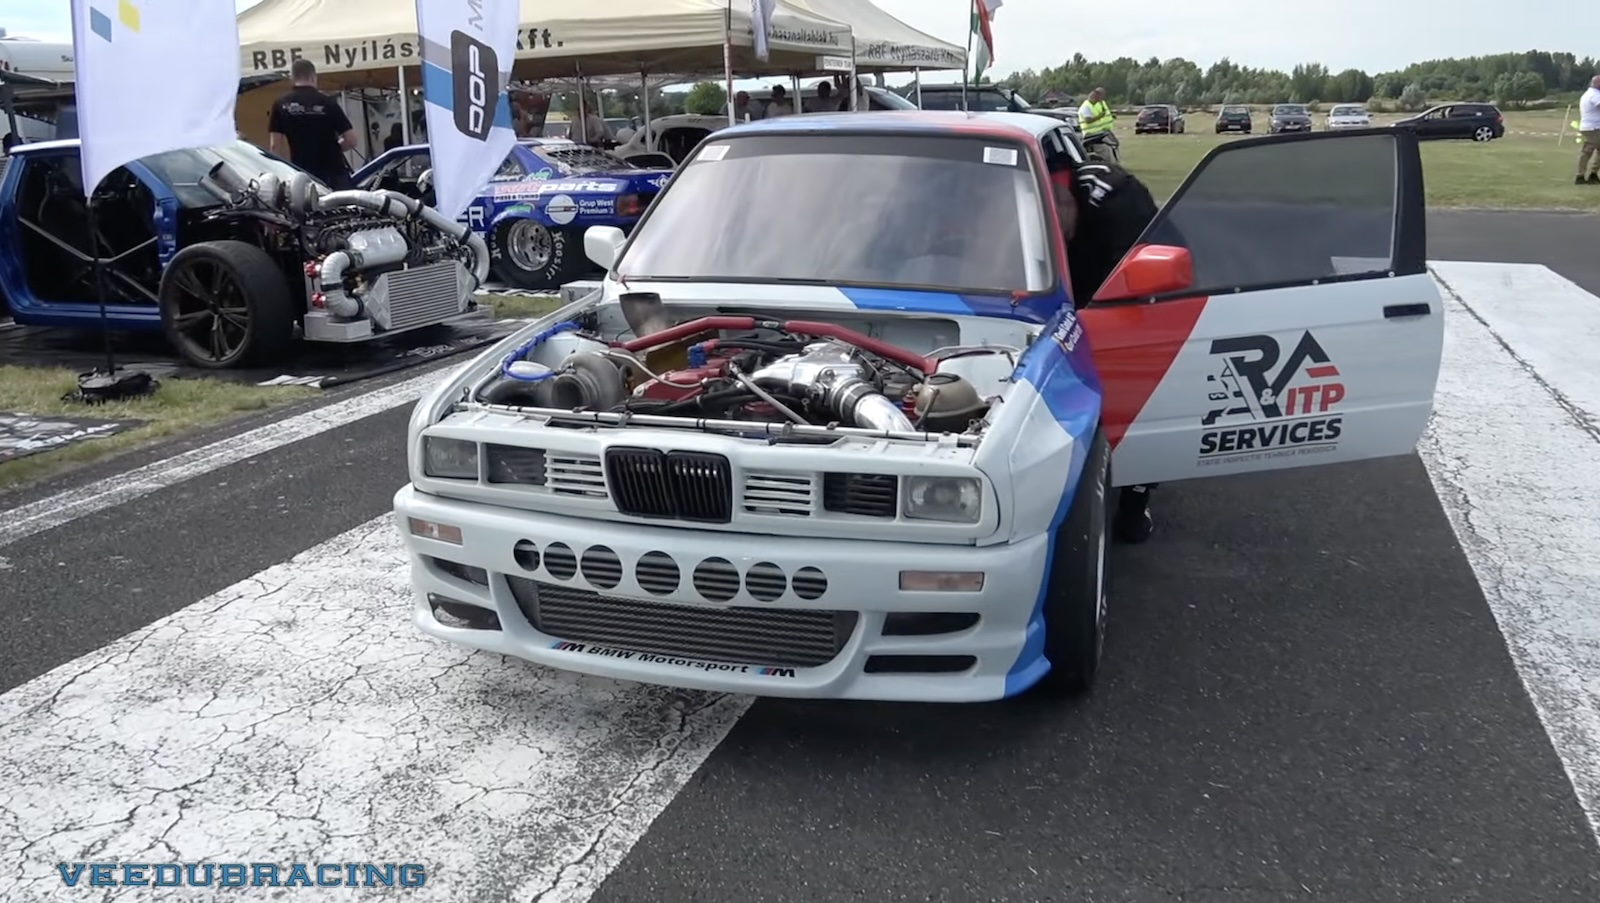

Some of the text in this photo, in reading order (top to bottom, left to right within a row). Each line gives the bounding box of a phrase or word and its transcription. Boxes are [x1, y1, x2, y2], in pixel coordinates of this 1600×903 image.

[324, 38, 421, 68] Nyílás
[468, 44, 487, 134] DOP
[579, 199, 614, 208] Grup West
[1285, 383, 1345, 416] ITP
[1199, 418, 1342, 454] SERVICES
[587, 646, 636, 659] BMW
[638, 653, 749, 672] Motorsport
